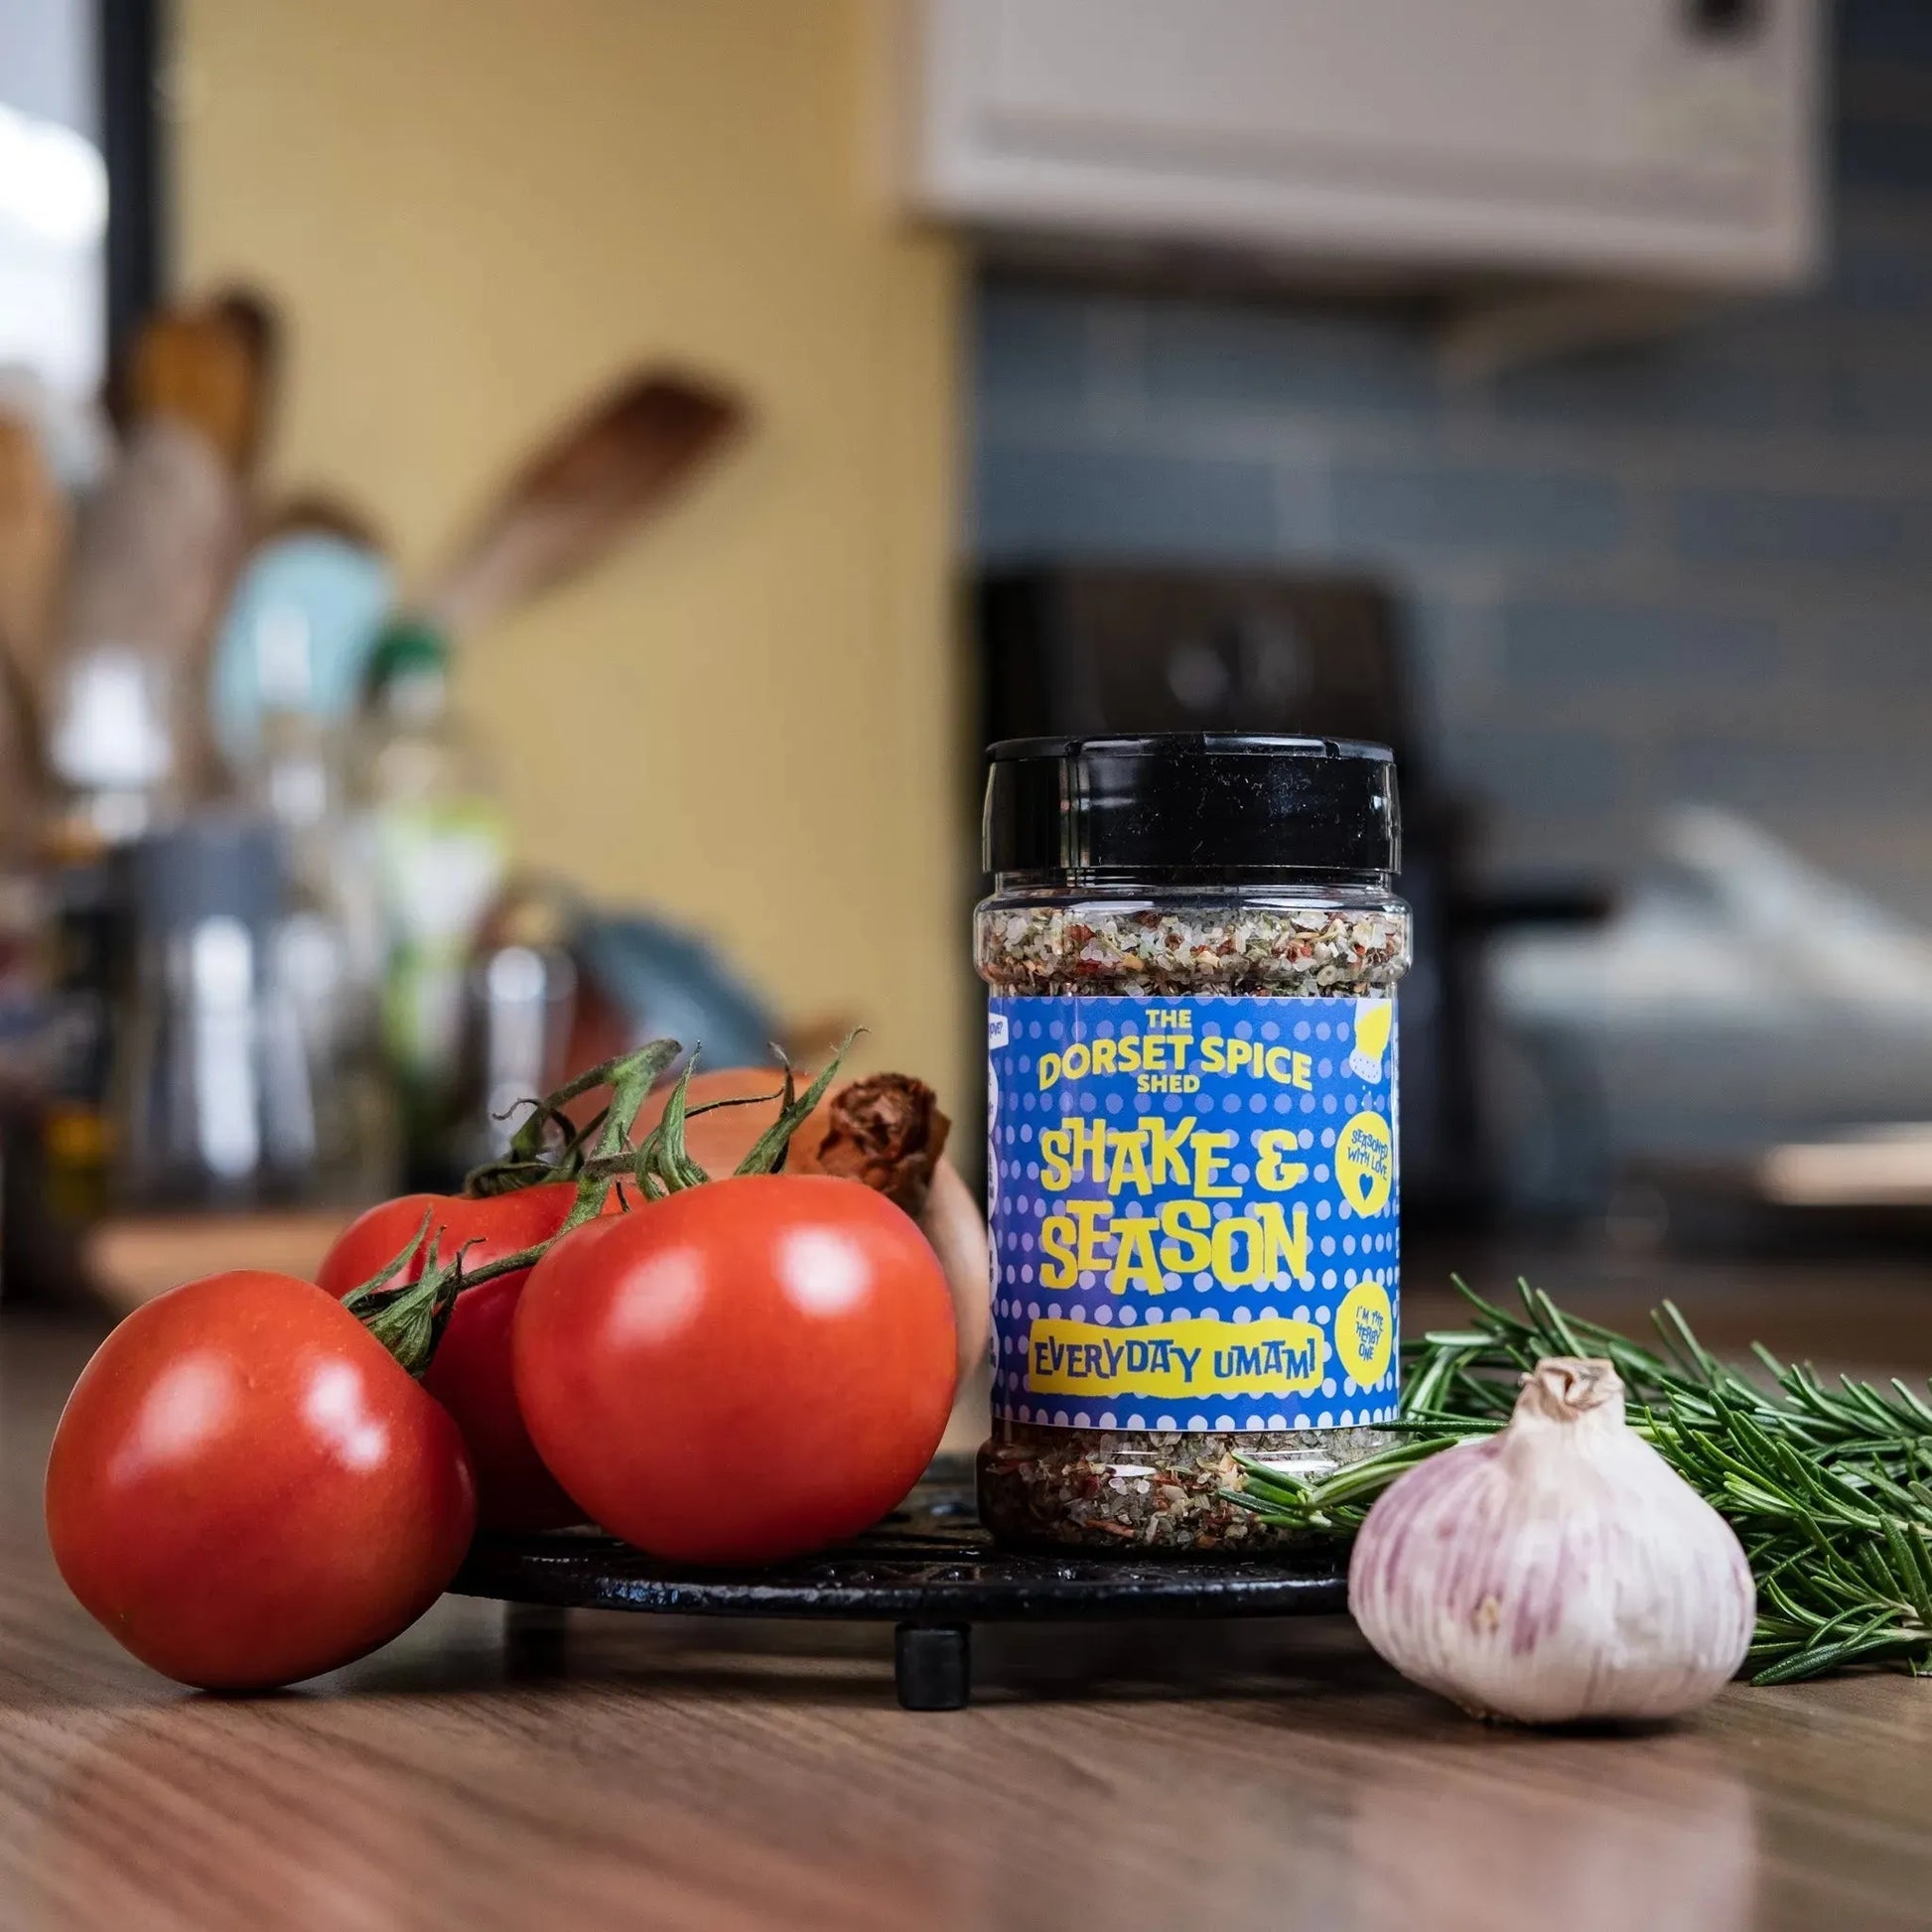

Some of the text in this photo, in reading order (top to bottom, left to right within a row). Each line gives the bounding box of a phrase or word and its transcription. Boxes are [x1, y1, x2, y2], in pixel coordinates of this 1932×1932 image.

[1146, 1009, 1192, 1029] THE
[1039, 1035, 1312, 1091] DORSET SPICE
[1137, 1074, 1200, 1093] SHED
[1040, 1116, 1243, 1198] SHAKE
[1255, 1129, 1307, 1191] &
[1351, 1129, 1388, 1161] SEASONED
[1347, 1146, 1388, 1181] WITH LOVE
[1040, 1199, 1308, 1296] SEASON
[1356, 1305, 1384, 1326] I'M THE
[1355, 1321, 1383, 1346] HERBY
[1035, 1335, 1201, 1383] EVERYDAY
[1213, 1337, 1316, 1380] UMAMI
[1358, 1343, 1374, 1361] ONE
